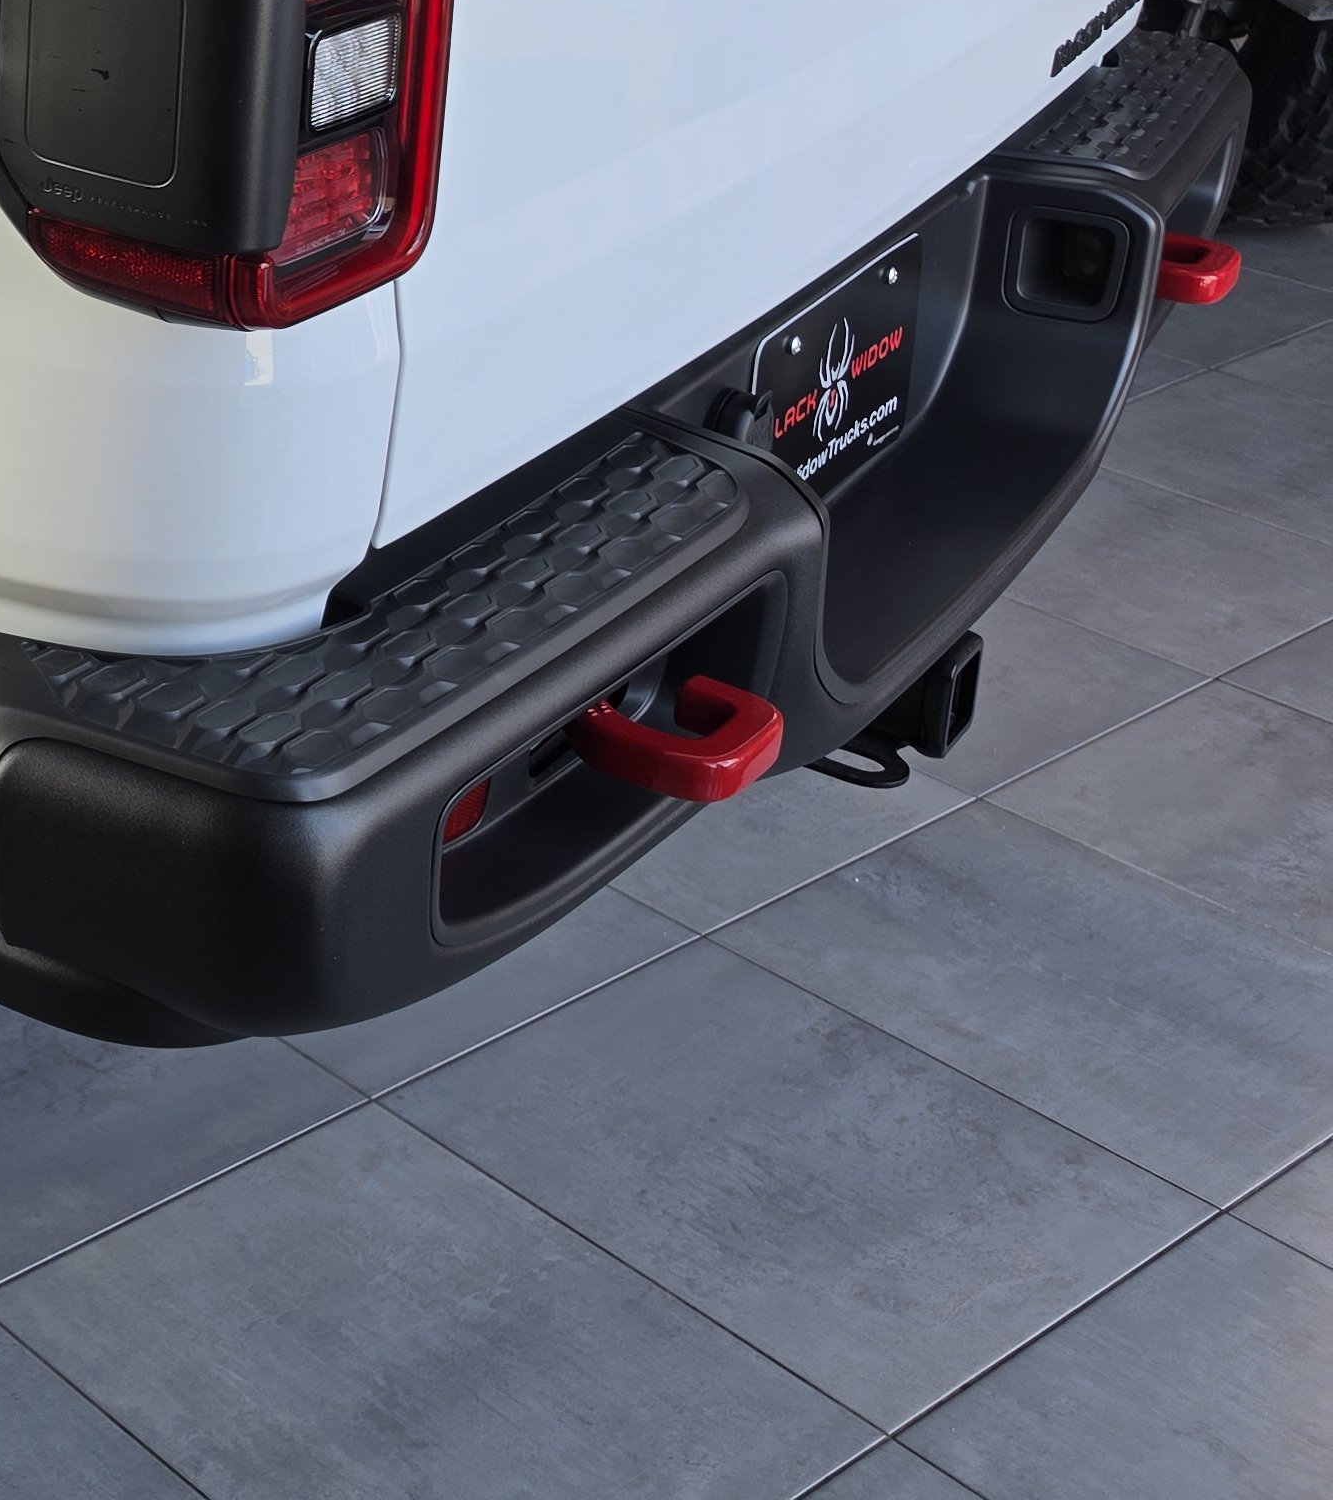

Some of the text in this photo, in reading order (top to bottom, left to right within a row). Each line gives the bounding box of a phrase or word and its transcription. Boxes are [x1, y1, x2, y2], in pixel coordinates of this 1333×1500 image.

[42, 175, 84, 203] Jeep
[773, 325, 903, 439] LACK WIDOW
[795, 395, 898, 482] dowTrucks.com
